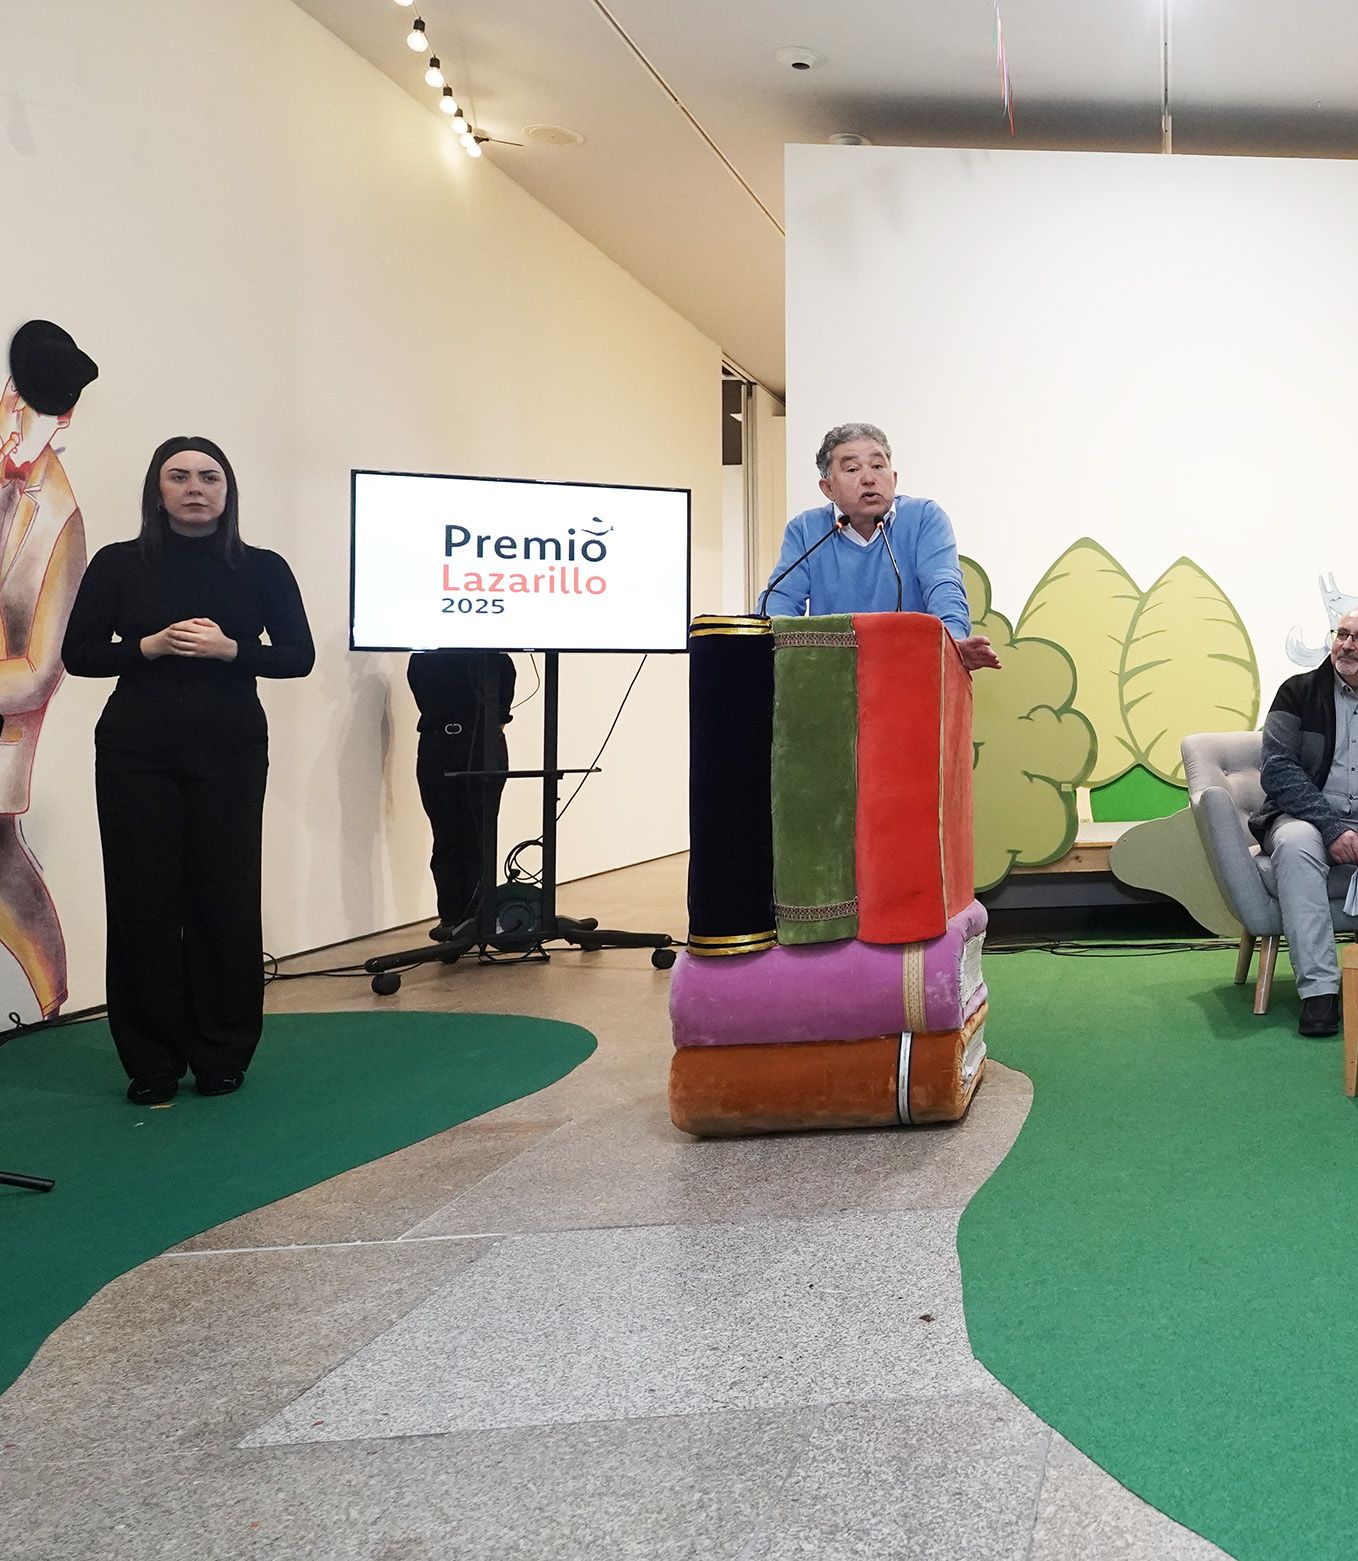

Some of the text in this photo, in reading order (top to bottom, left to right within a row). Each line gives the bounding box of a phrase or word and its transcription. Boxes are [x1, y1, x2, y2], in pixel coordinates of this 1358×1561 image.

[444, 523, 608, 563] Premio
[441, 563, 607, 595] Lazarillo
[440, 597, 506, 614] 2025
